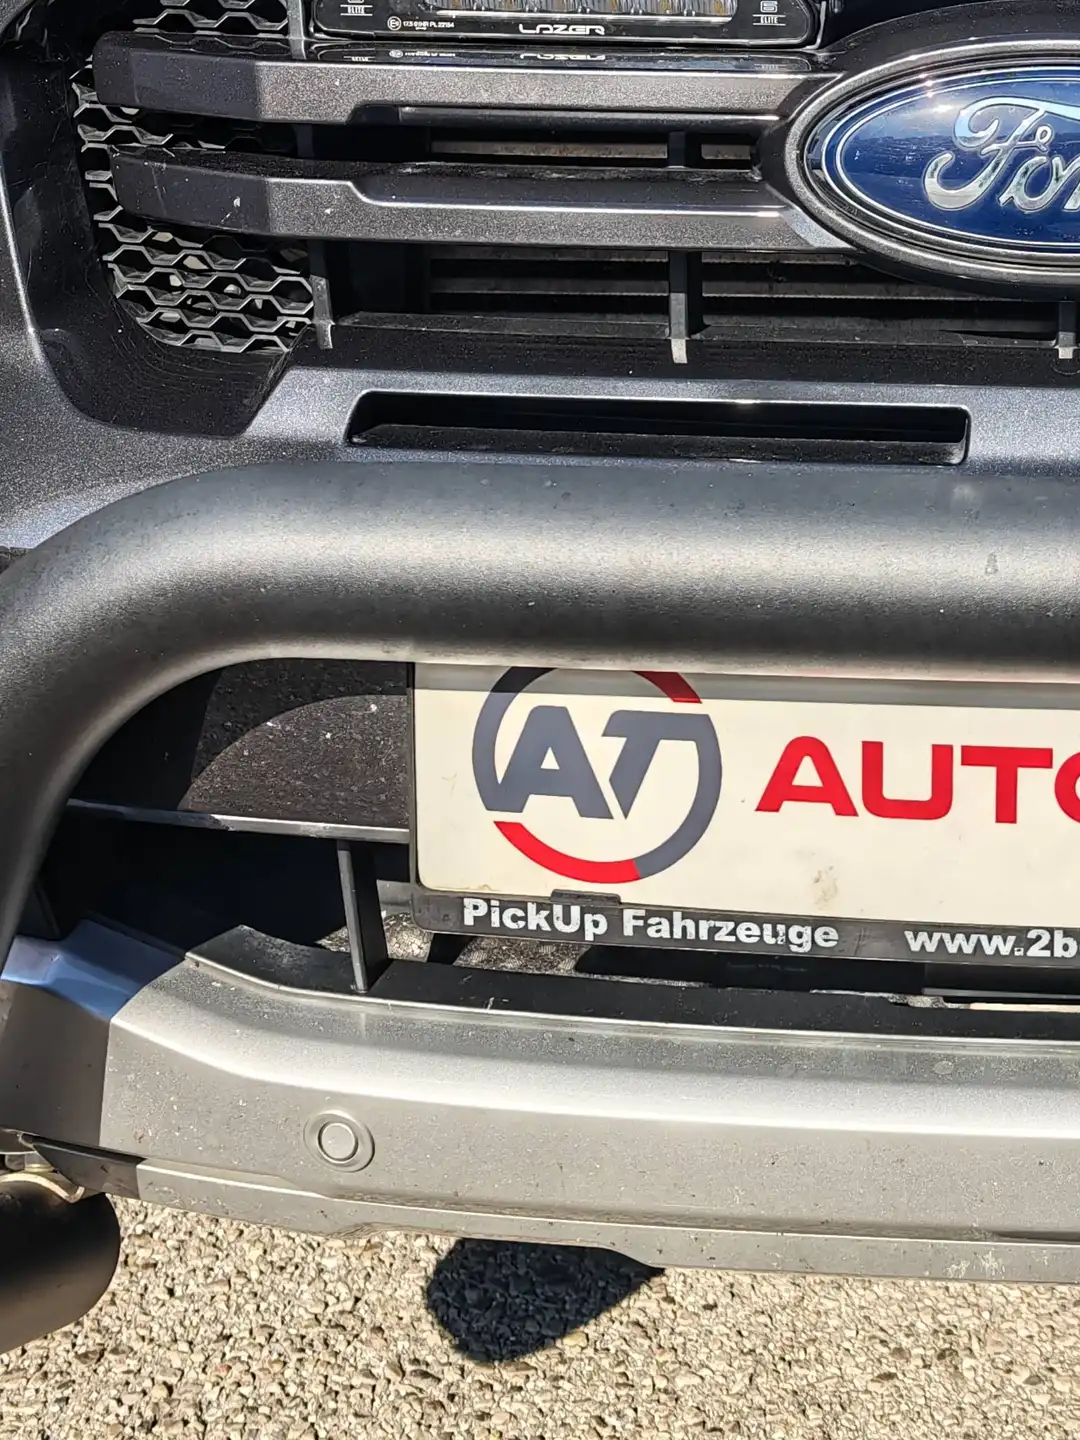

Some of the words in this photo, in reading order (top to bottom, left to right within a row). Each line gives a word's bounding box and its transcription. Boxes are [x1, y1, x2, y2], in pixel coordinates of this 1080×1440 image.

[519, 23, 605, 35] LAZER
[462, 896, 608, 941] PickUp
[622, 908, 839, 953] Fahrzeuge
